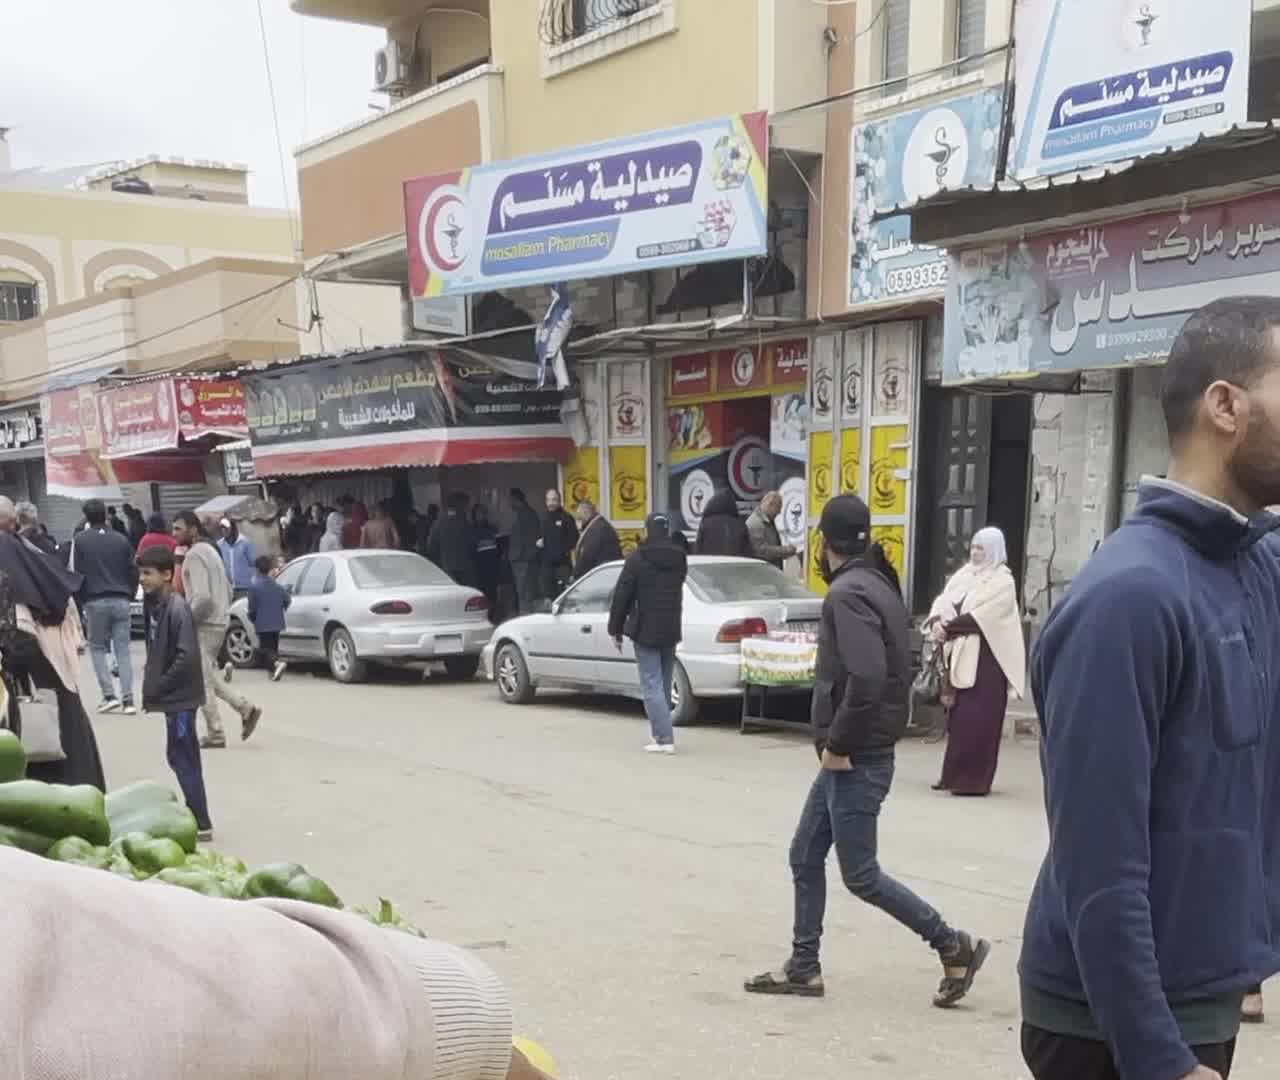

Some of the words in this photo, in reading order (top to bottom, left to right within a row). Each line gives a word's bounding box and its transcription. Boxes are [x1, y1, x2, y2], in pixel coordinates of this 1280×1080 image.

[1137, 64, 1227, 104] صيدلية
[1099, 118, 1156, 140] Pharmacy
[589, 159, 694, 210] صيدلية
[547, 229, 613, 256] Pharmacy
[1139, 221, 1223, 266] ماركت
[887, 261, 950, 292] 0599352
